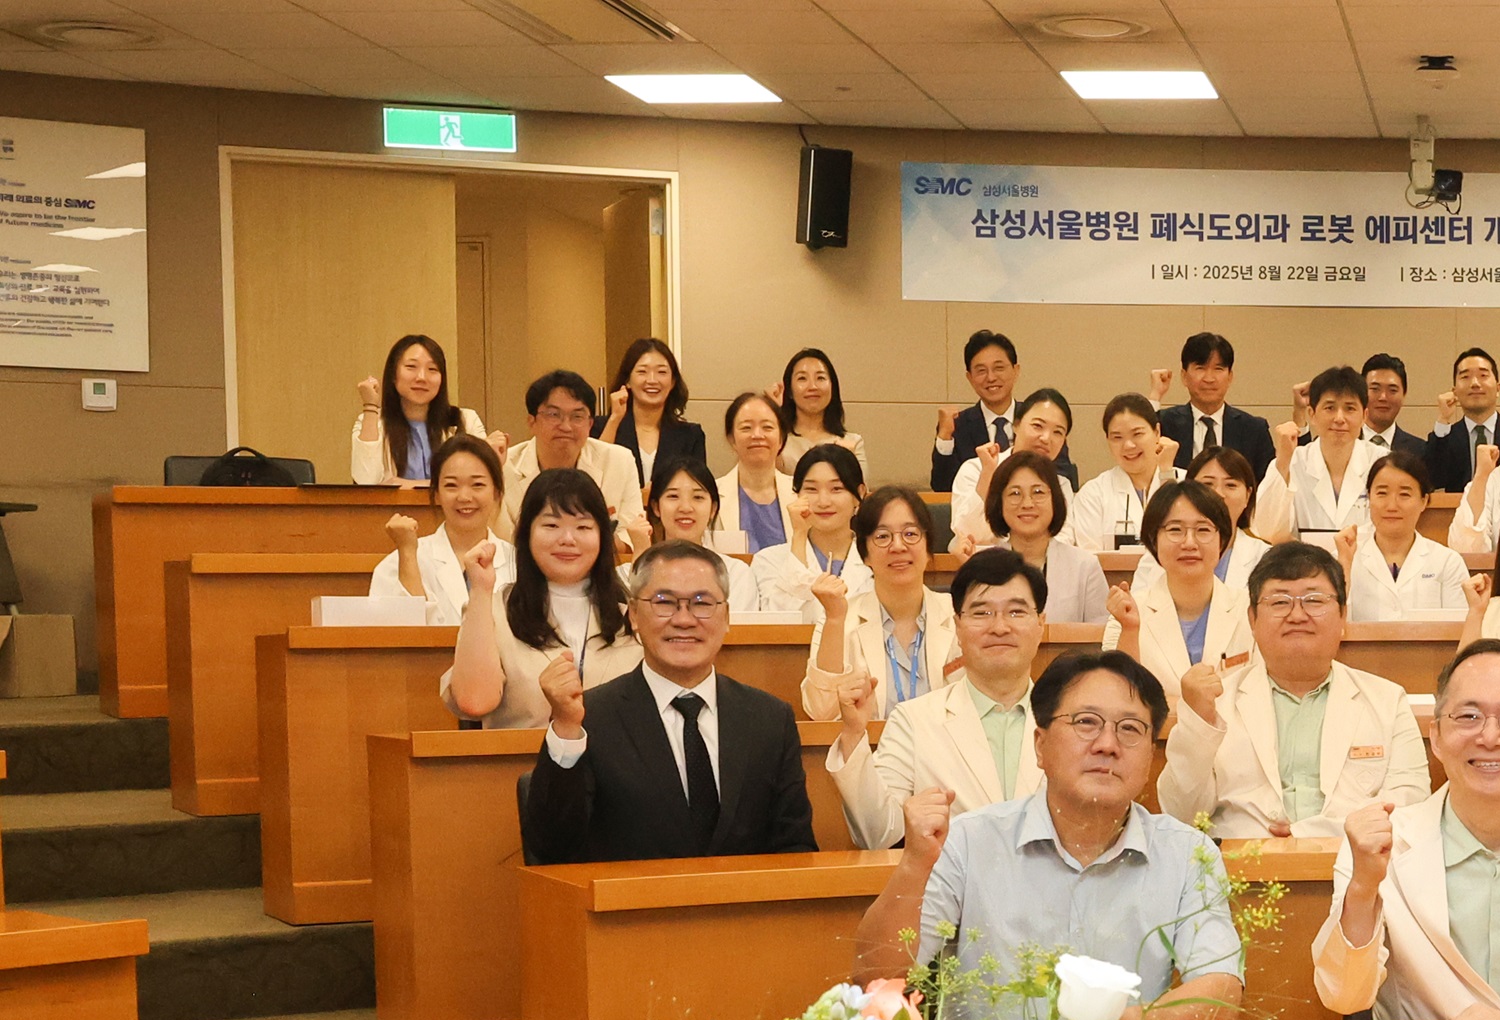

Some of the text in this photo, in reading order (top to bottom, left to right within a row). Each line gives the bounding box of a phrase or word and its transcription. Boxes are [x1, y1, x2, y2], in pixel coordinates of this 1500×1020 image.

[983, 184, 1039, 198] 삼성서울병원
[44, 196, 62, 208] 중심
[970, 208, 1139, 242] 삼성서울병원
[1150, 212, 1291, 244] 폐식도외과
[1300, 214, 1355, 245] 로봇
[1364, 214, 1473, 246] 에피센터
[1160, 264, 1189, 281] 일시
[1202, 264, 1253, 281] 2025년
[1258, 265, 1282, 282] 8월
[1286, 265, 1319, 282] 22일
[1323, 265, 1367, 283] 금요일
[1409, 266, 1438, 283] 장소
